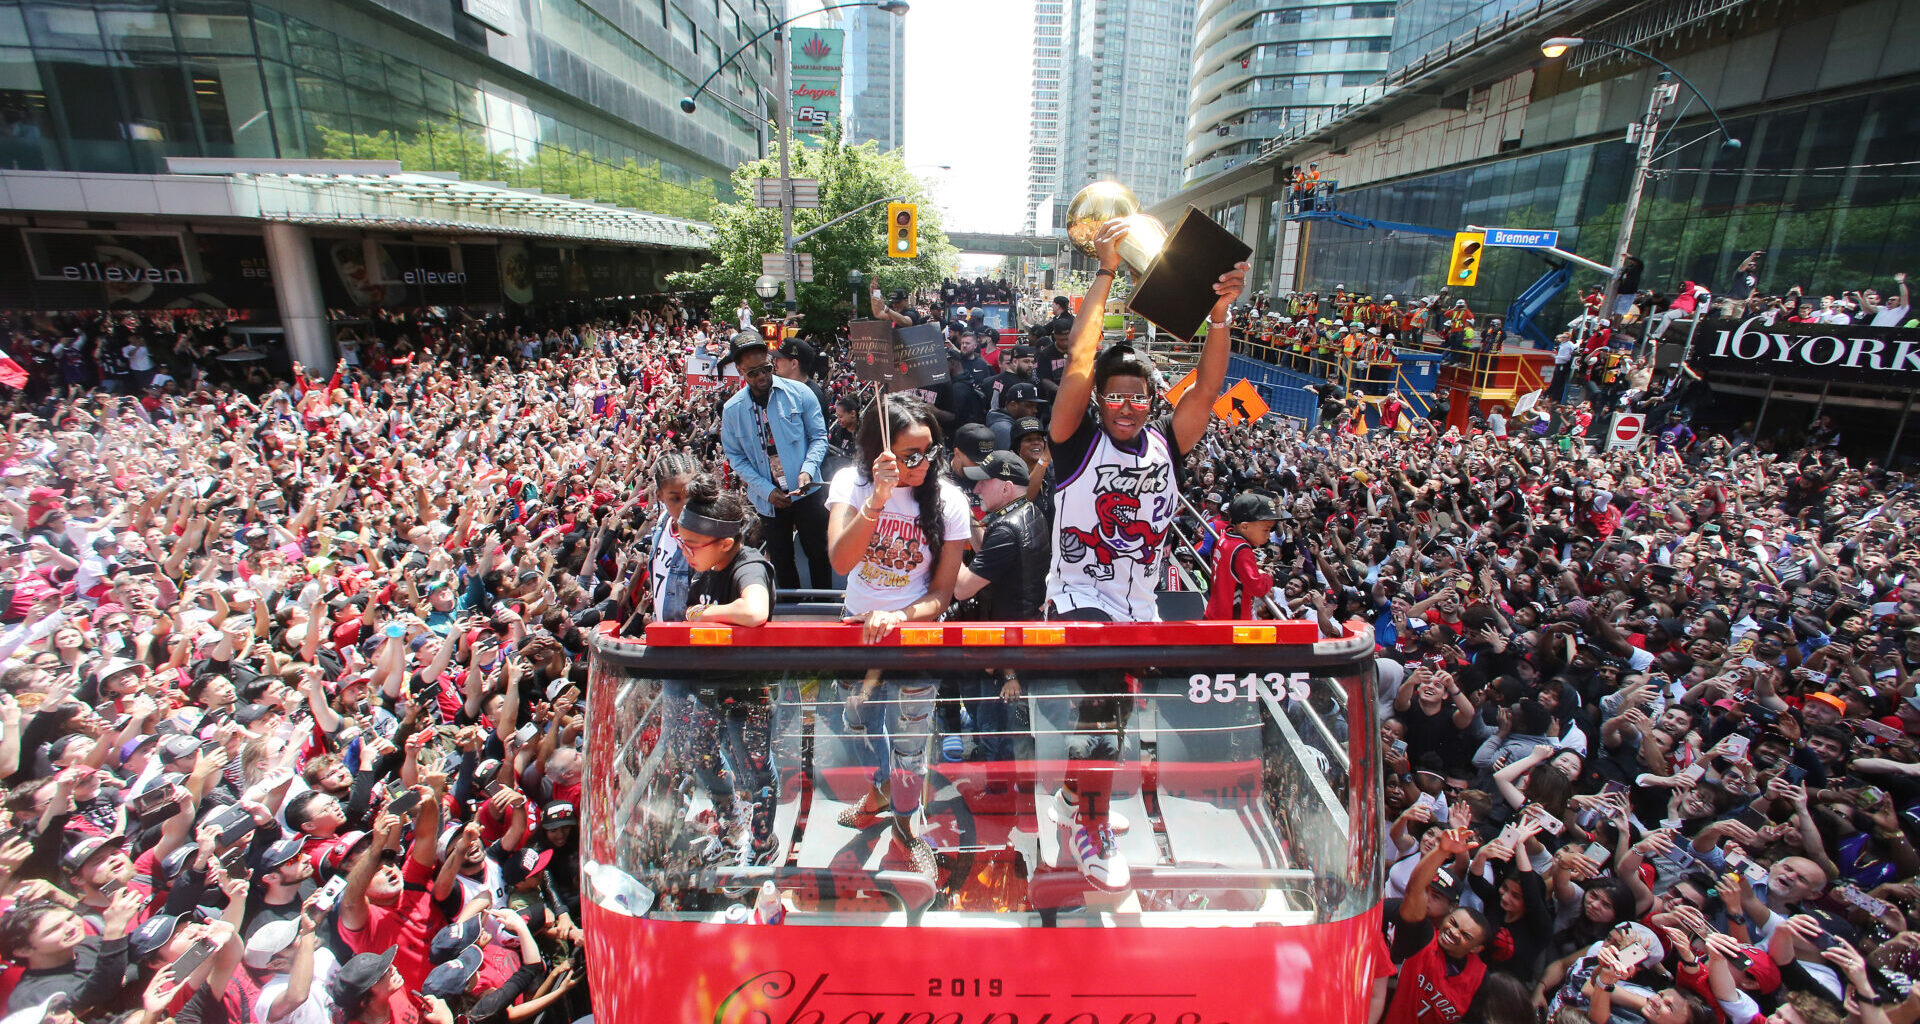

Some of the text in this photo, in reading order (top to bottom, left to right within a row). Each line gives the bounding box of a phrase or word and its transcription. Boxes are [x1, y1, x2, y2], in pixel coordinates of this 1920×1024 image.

[798, 106, 829, 126] RS
[1495, 231, 1540, 244] Bremner
[63, 262, 184, 283] elleven
[404, 267, 467, 284] elleven
[1017, 389, 1023, 398] K
[655, 572, 666, 599] 7
[1188, 672, 1311, 704] 85135
[928, 978, 1003, 997] 2019
[1417, 999, 1432, 1017] 7
